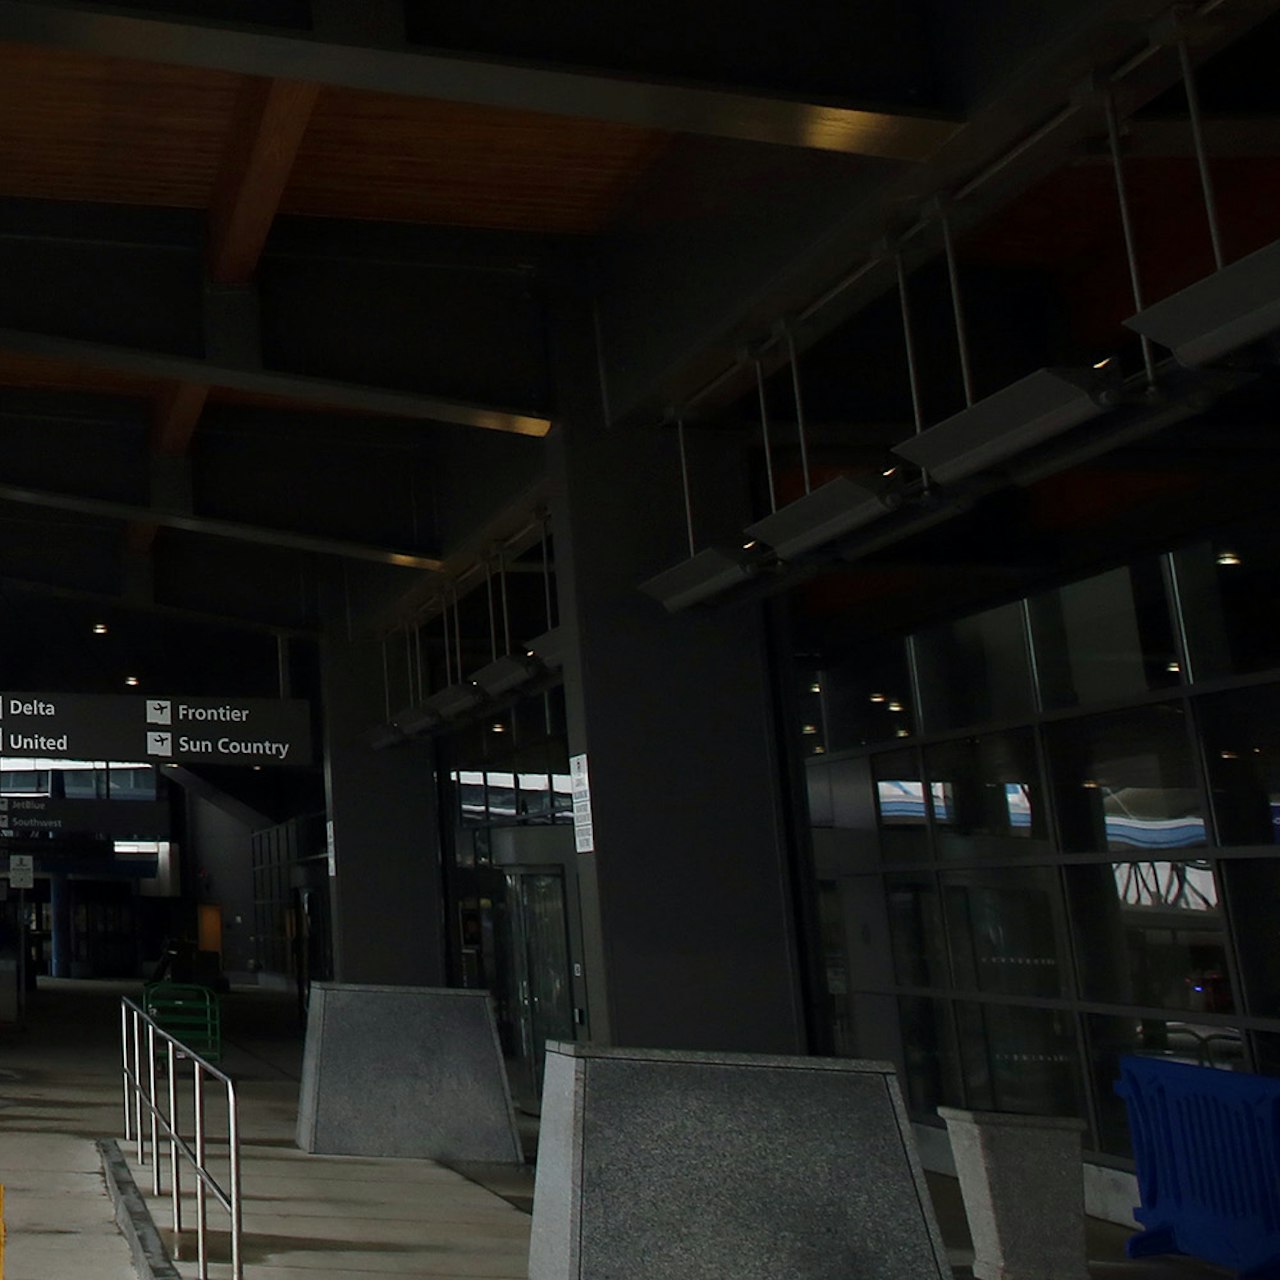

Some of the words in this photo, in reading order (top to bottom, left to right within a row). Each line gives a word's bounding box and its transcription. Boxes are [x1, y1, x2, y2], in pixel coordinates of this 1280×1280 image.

[10, 700, 55, 716] Delta
[178, 704, 249, 722] Frontier
[10, 733, 68, 751] United
[179, 737, 212, 753] Sun
[217, 738, 289, 759] Country
[12, 800, 46, 810] JetBlue
[12, 817, 62, 828] Southwest
